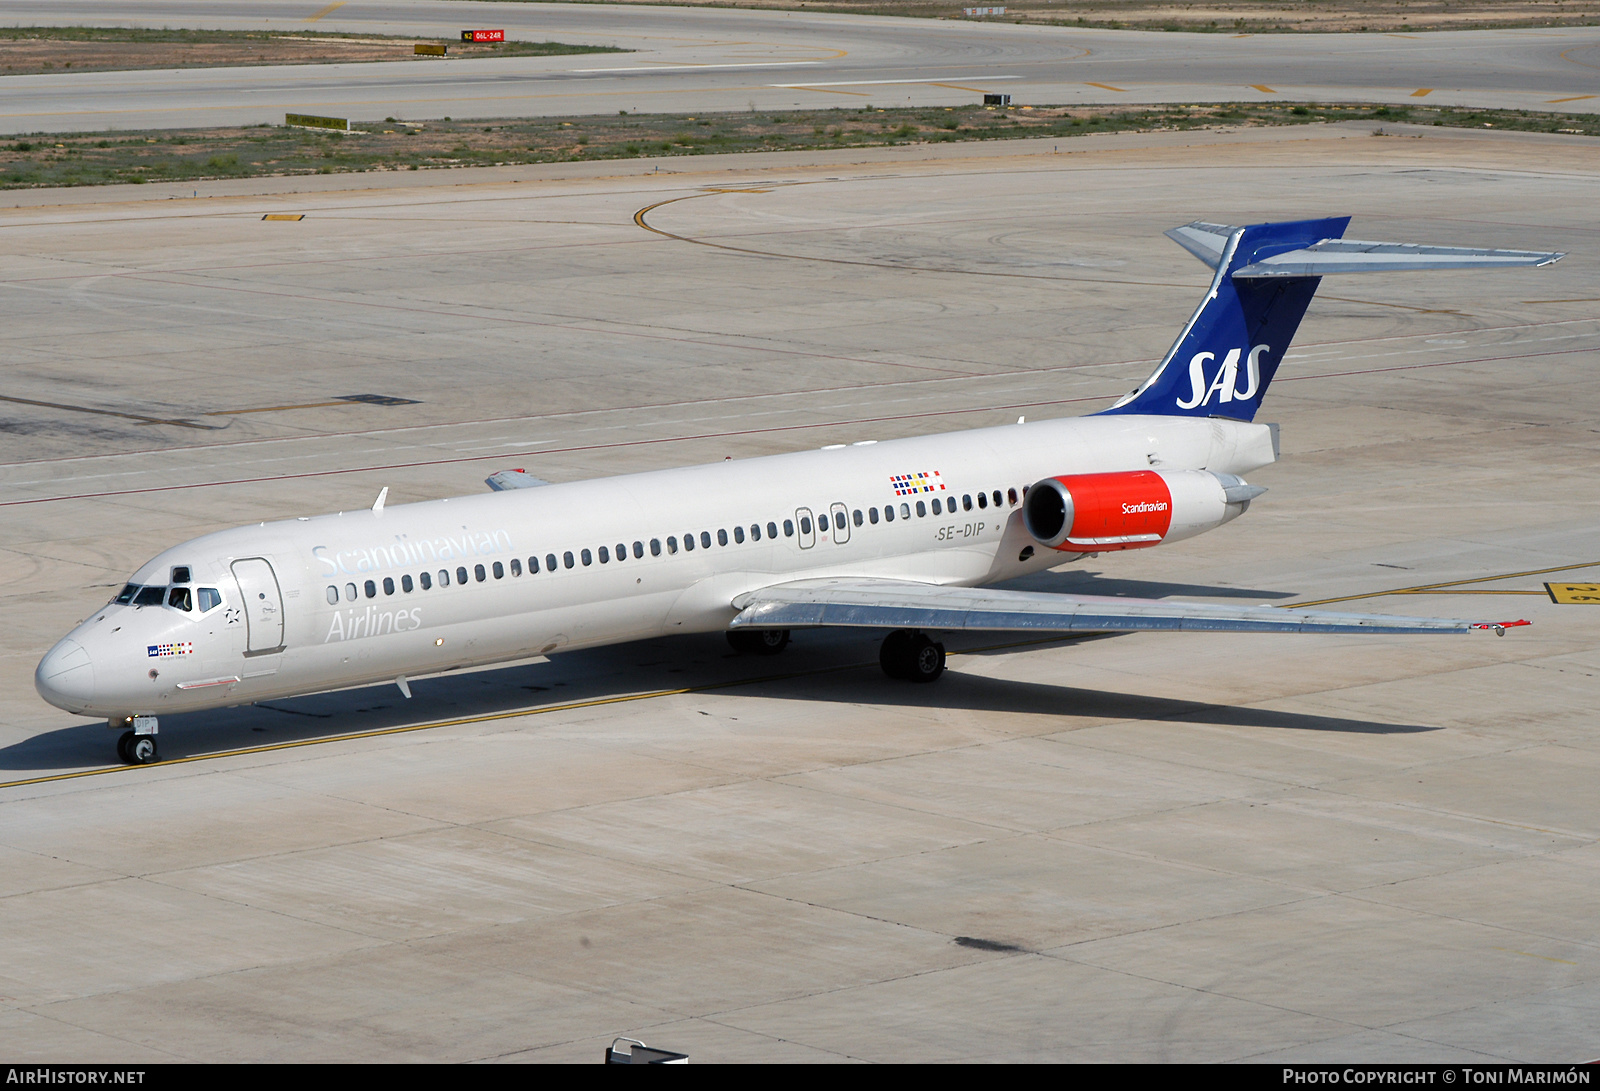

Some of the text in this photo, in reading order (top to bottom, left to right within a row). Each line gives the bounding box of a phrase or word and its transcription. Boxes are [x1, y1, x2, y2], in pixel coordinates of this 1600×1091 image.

[1175, 344, 1270, 410] SAS
[1121, 500, 1168, 514] Scandinavian
[937, 521, 985, 541] SE-DIP
[311, 525, 514, 578] Scandinavian
[324, 605, 422, 643] Airlines
[136, 719, 149, 728] DIP
